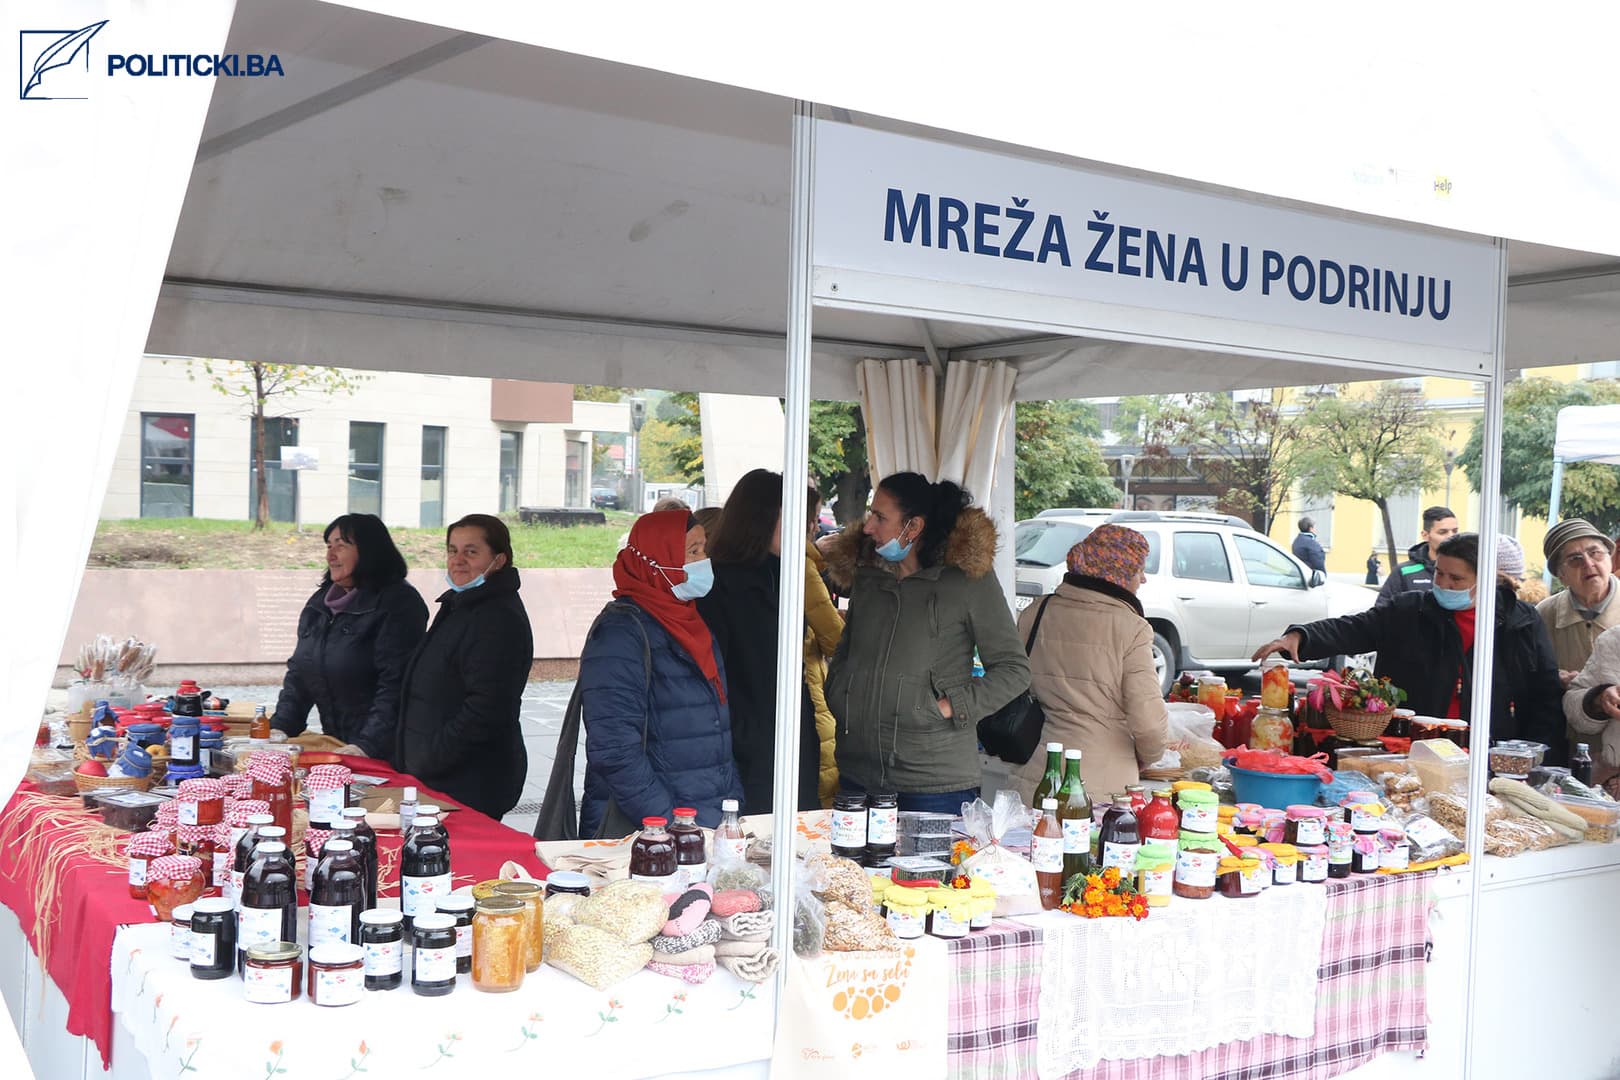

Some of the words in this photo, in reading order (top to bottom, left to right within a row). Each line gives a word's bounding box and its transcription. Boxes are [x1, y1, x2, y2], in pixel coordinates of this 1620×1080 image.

[1433, 179, 1453, 194] Help
[884, 187, 1072, 267] MREŽA
[1084, 209, 1208, 286] ŽENA
[1221, 242, 1249, 292] U
[1261, 249, 1451, 321] PODRINJU
